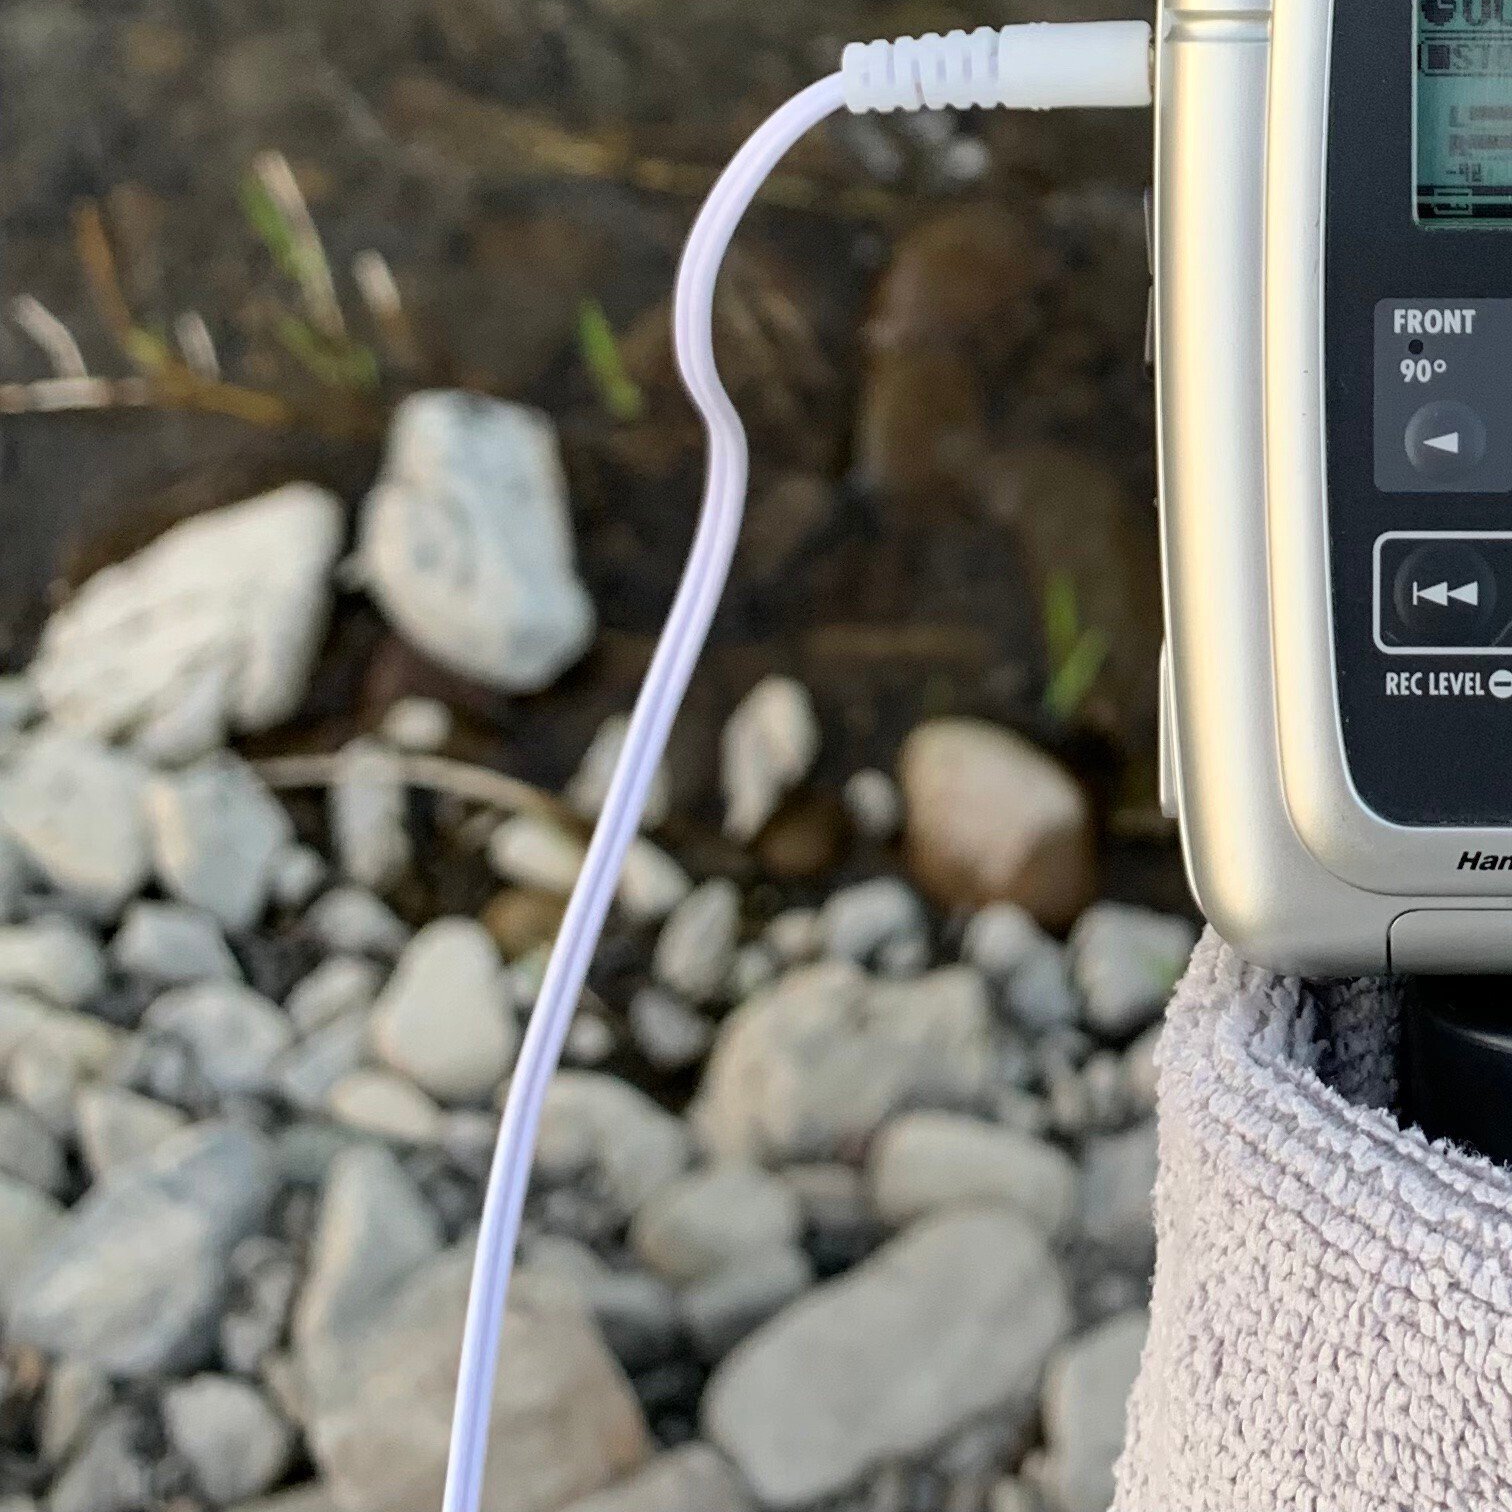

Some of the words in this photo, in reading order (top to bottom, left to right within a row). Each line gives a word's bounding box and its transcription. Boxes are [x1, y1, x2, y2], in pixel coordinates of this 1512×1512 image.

[1394, 309, 1476, 333] FRONT
[1400, 359, 1447, 382] 90°
[1386, 672, 1423, 696] REC
[1429, 672, 1485, 696] LEVEL
